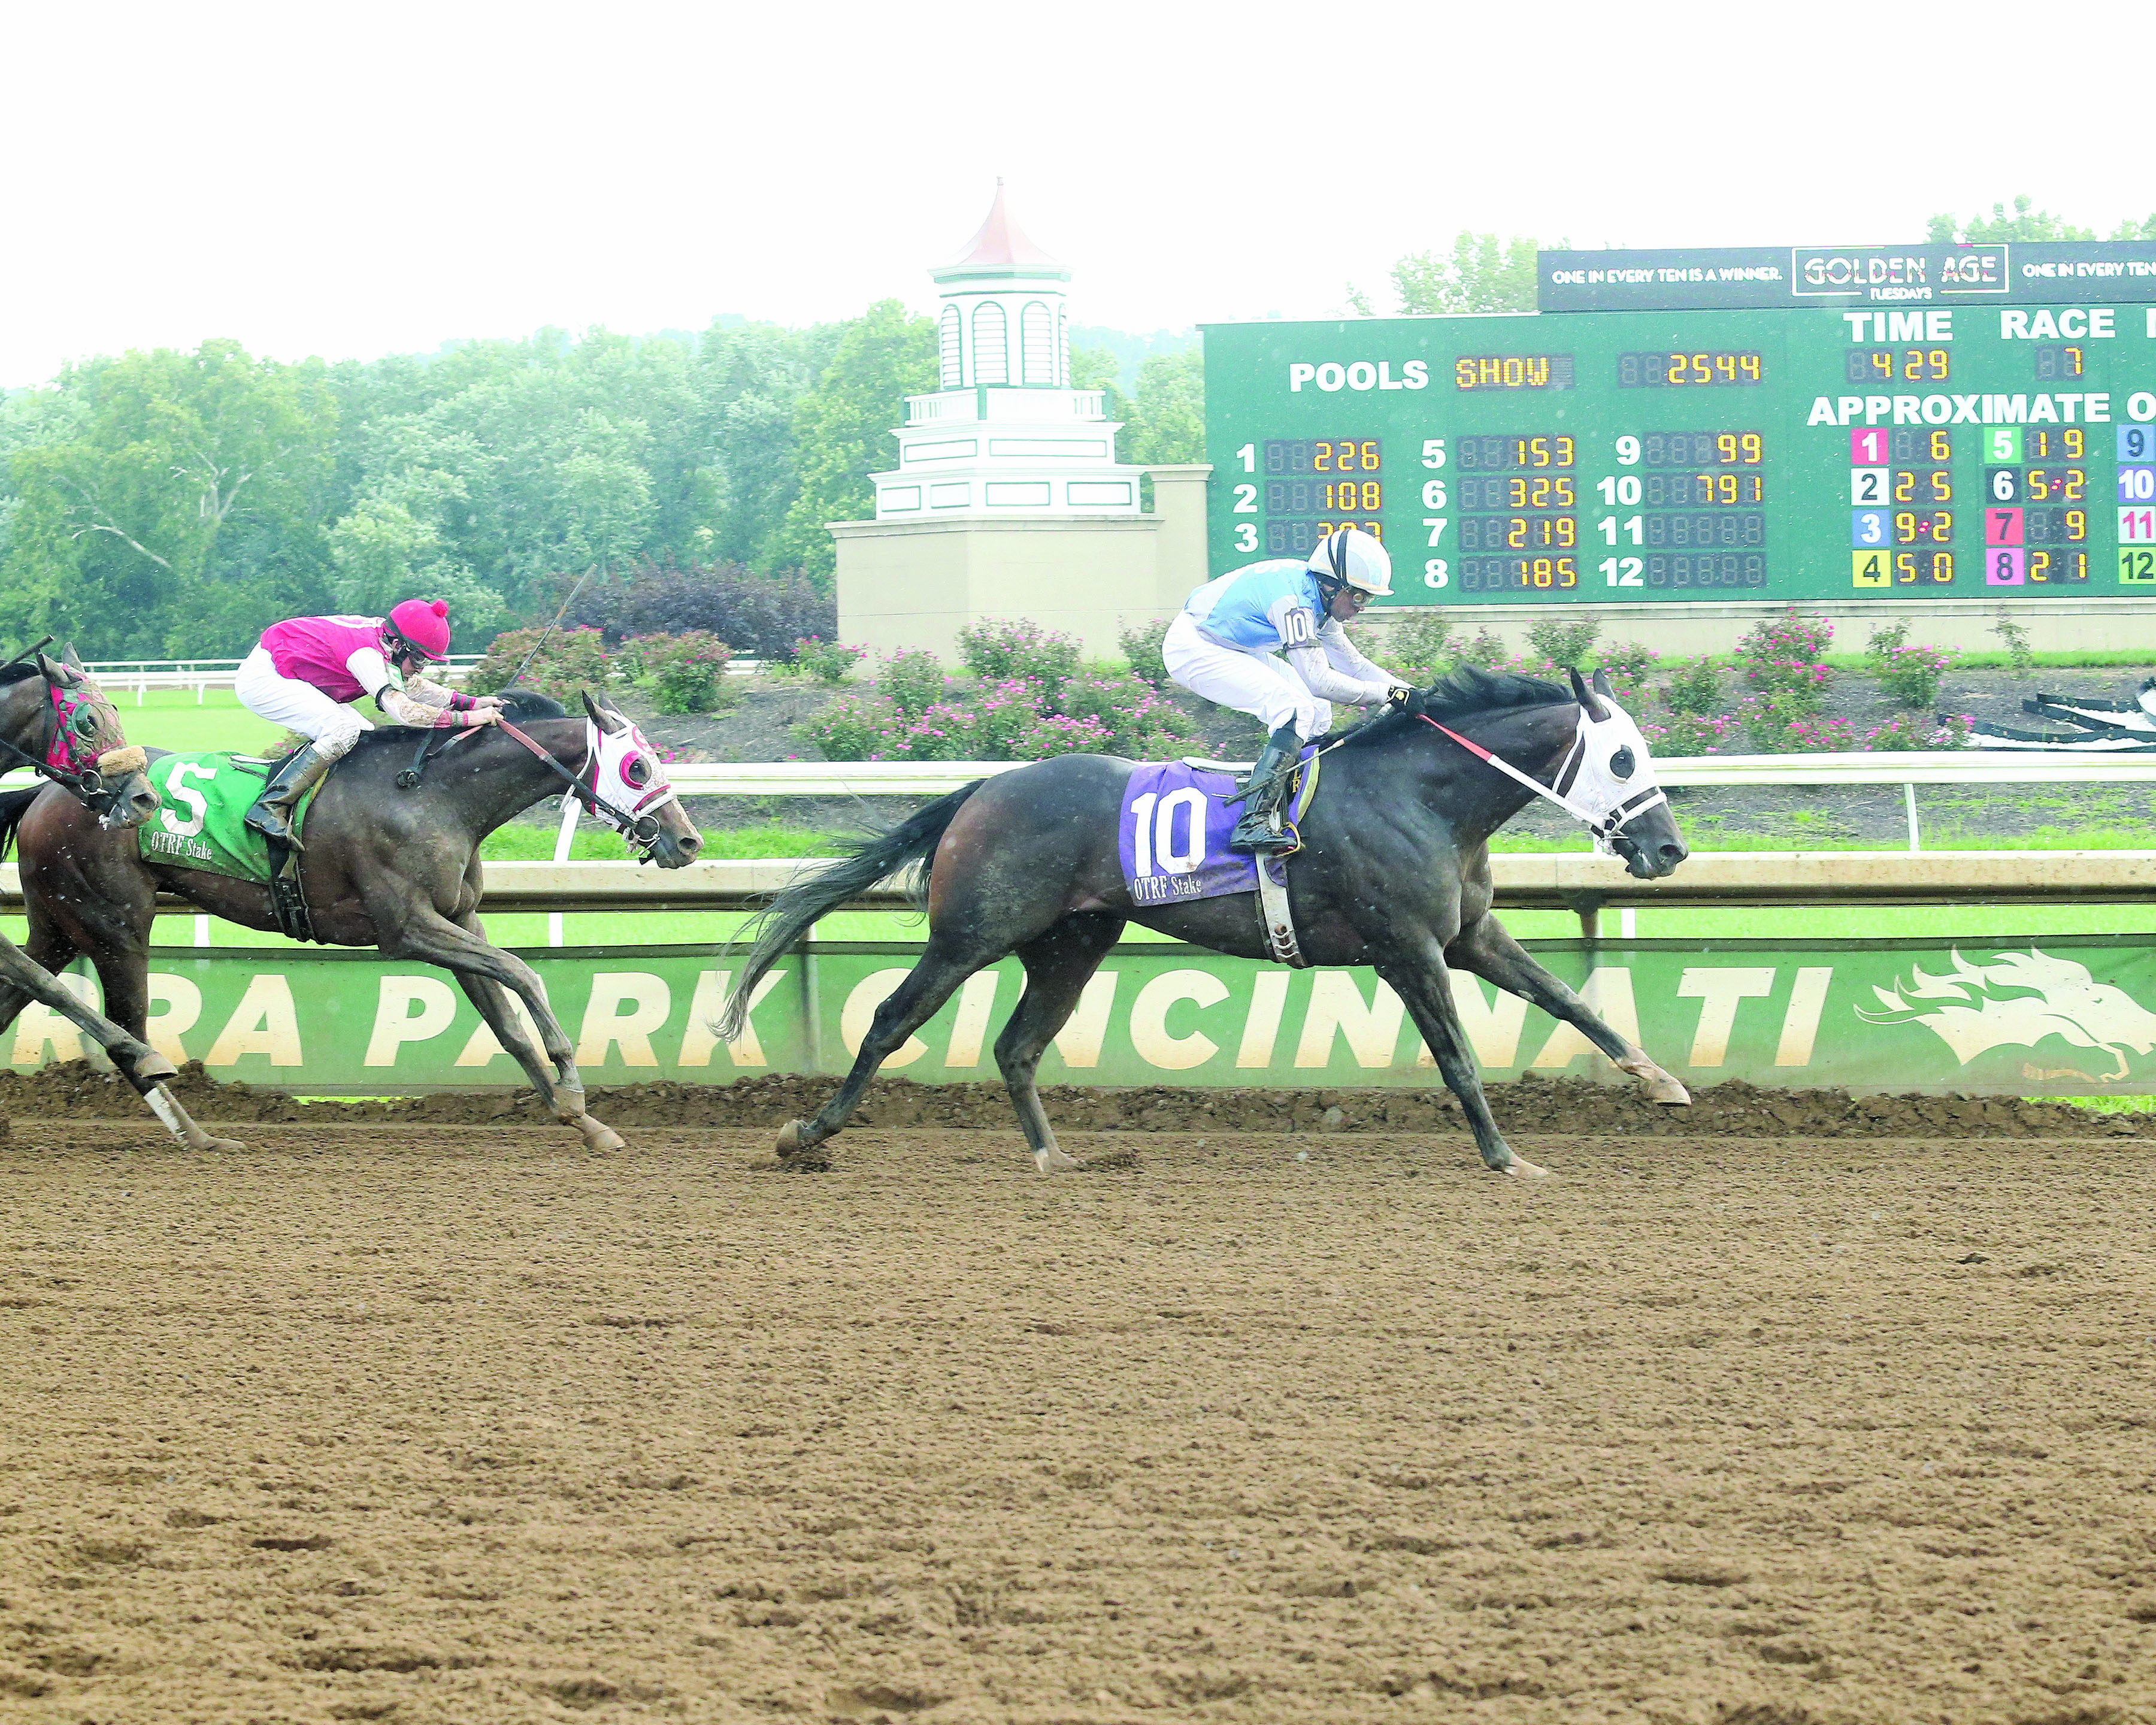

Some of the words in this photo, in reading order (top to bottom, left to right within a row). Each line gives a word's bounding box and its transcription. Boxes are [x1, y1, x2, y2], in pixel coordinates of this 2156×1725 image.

[1552, 269, 1585, 284] ONE
[1588, 269, 1604, 283] IN
[1607, 268, 1655, 283] EVERY
[1657, 268, 1687, 283] TEN
[1688, 268, 1704, 282] IS
[1705, 268, 1718, 282] A
[1719, 267, 1783, 282] WINNER.
[1804, 257, 1926, 285] GOLDEN
[1940, 255, 1998, 282] AGE
[2022, 262, 2056, 277] ONE
[2058, 262, 2074, 277] IN
[2076, 262, 2125, 277] EVERY
[2127, 262, 2156, 276] TEN
[1870, 286, 1933, 300] TUESDAYS
[1843, 311, 1954, 342] TIME
[2000, 308, 2116, 340] RACE
[1289, 360, 1430, 392] POOLS
[1455, 358, 1550, 388] SHOW
[1667, 354, 1760, 384] 2544
[2064, 347, 2082, 375] 7
[1806, 393, 2111, 426] APPROXIMATE
[1236, 443, 1255, 473] 1
[1313, 441, 1380, 471] 226
[1421, 439, 1446, 469] 5
[1518, 437, 1574, 467] 153
[1616, 435, 1641, 465] 9
[1716, 433, 1761, 464] 99
[1862, 432, 1878, 462] 1
[1930, 431, 1951, 461] 6
[1993, 431, 2013, 459] 5
[2127, 429, 2144, 457] 9
[1233, 484, 1258, 514] 2
[1325, 481, 1381, 511] 108
[1422, 480, 1448, 510] 6
[1509, 477, 1574, 508] 325
[1597, 476, 1642, 506] 10
[1695, 474, 1761, 504] 791
[1861, 473, 1879, 501] 2
[1993, 470, 2014, 501] 6
[2118, 469, 2155, 500] 10
[1234, 523, 1259, 552] 3
[1422, 518, 1448, 547] 7
[1507, 517, 1575, 548] 219
[1598, 516, 1643, 546] 11
[1861, 513, 1882, 544] 3
[1996, 513, 2013, 540] 7
[2065, 510, 2086, 540] 9
[2122, 511, 2152, 539] 11
[1424, 558, 1449, 589] 8
[1520, 557, 1576, 588] 185
[1598, 556, 1644, 587] 12
[1863, 555, 1881, 583] 4
[1996, 552, 2013, 581] 8
[2121, 552, 2154, 580] 12
[1285, 612, 1308, 647] 10
[387, 666, 404, 689] 5
[159, 761, 218, 837] 5
[150, 831, 184, 856] OTRF
[186, 838, 213, 861] Stake
[1130, 786, 1208, 877] 10
[1134, 875, 1167, 900] OTRF
[1170, 876, 1202, 897] Stake
[364, 970, 788, 1067] PARK
